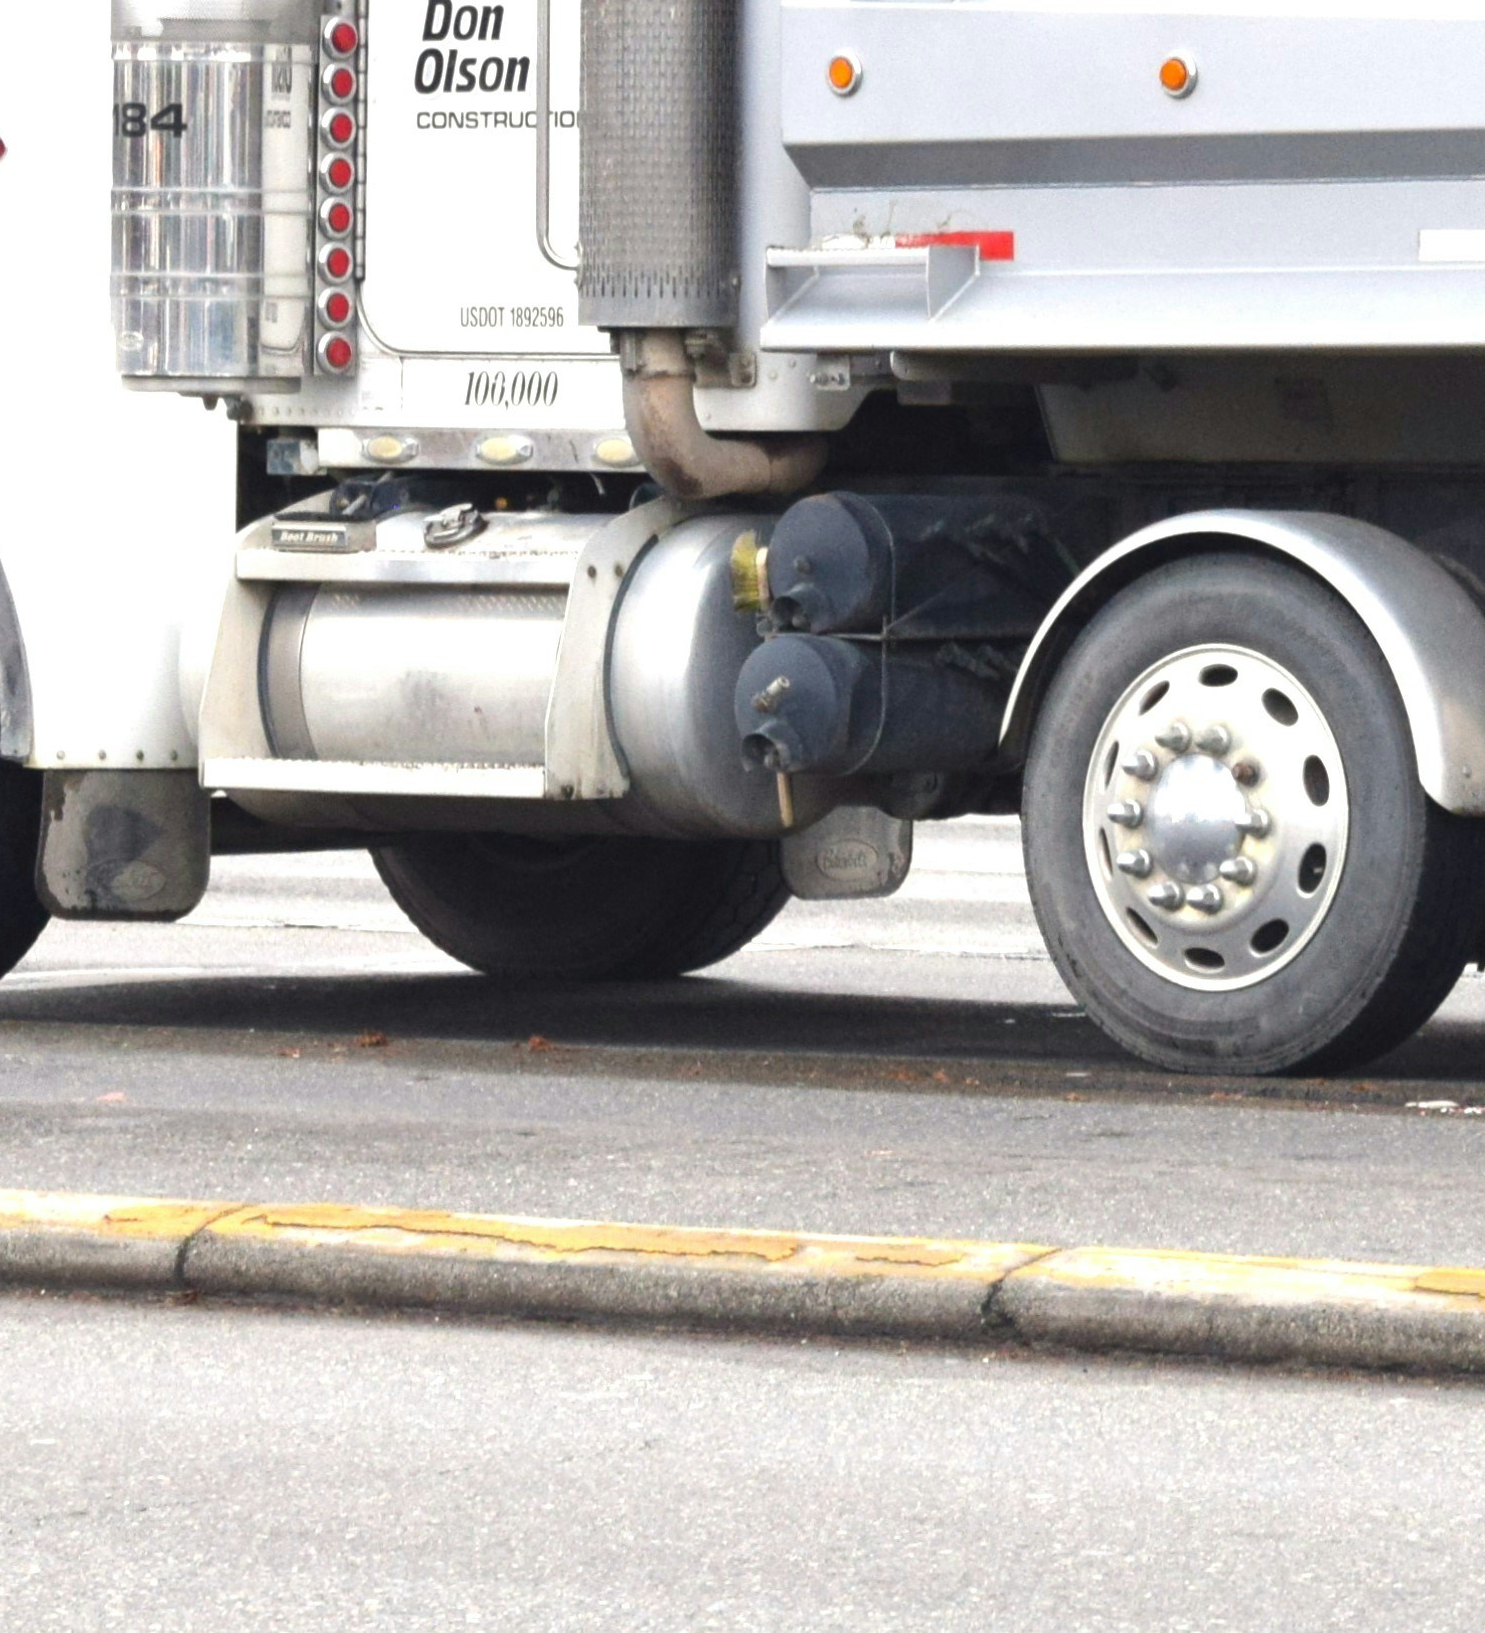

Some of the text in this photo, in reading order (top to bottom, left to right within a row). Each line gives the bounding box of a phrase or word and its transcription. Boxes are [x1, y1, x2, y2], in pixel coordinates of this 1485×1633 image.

[414, 48, 530, 94] Olson
[416, 110, 582, 130] CONSTRUCIO
[460, 306, 564, 328] USDOT 1892596
